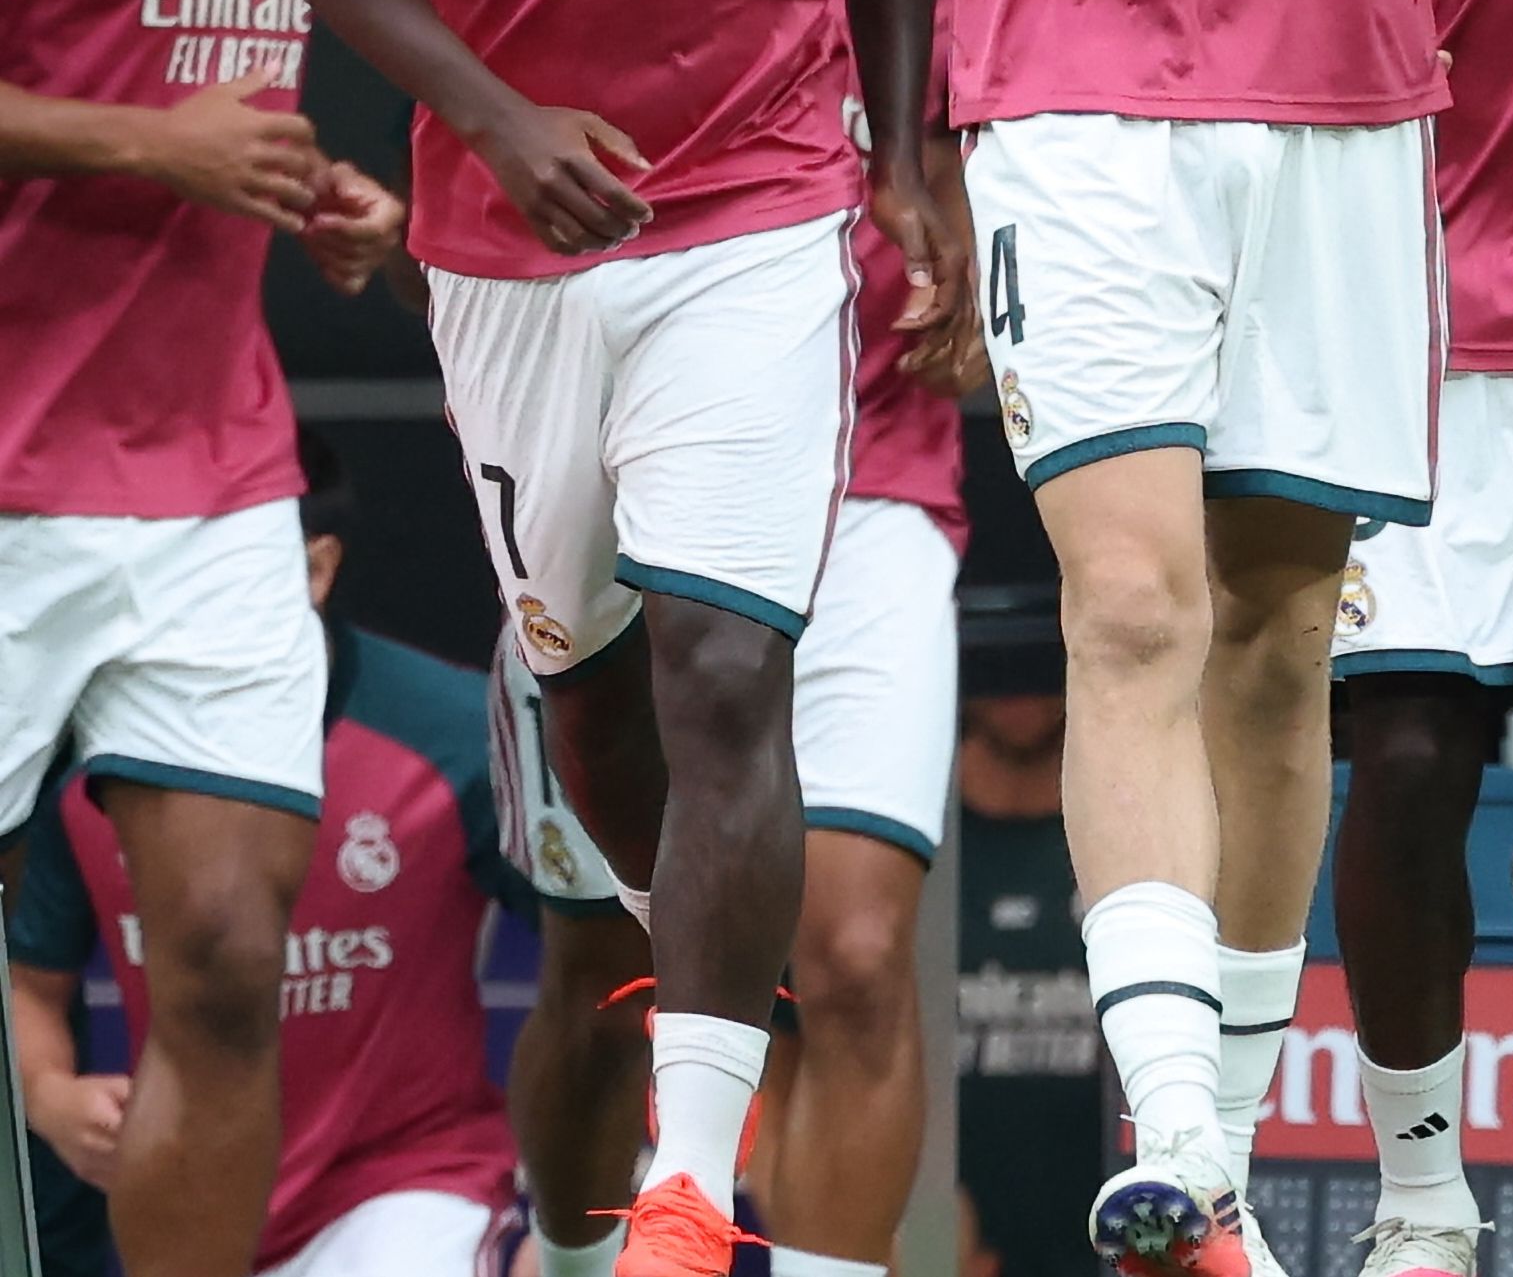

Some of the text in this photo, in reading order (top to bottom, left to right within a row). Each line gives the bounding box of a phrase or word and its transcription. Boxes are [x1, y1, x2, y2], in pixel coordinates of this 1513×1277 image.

[165, 35, 217, 85] FLY
[989, 223, 1026, 347] 4
[480, 462, 529, 580] 7
